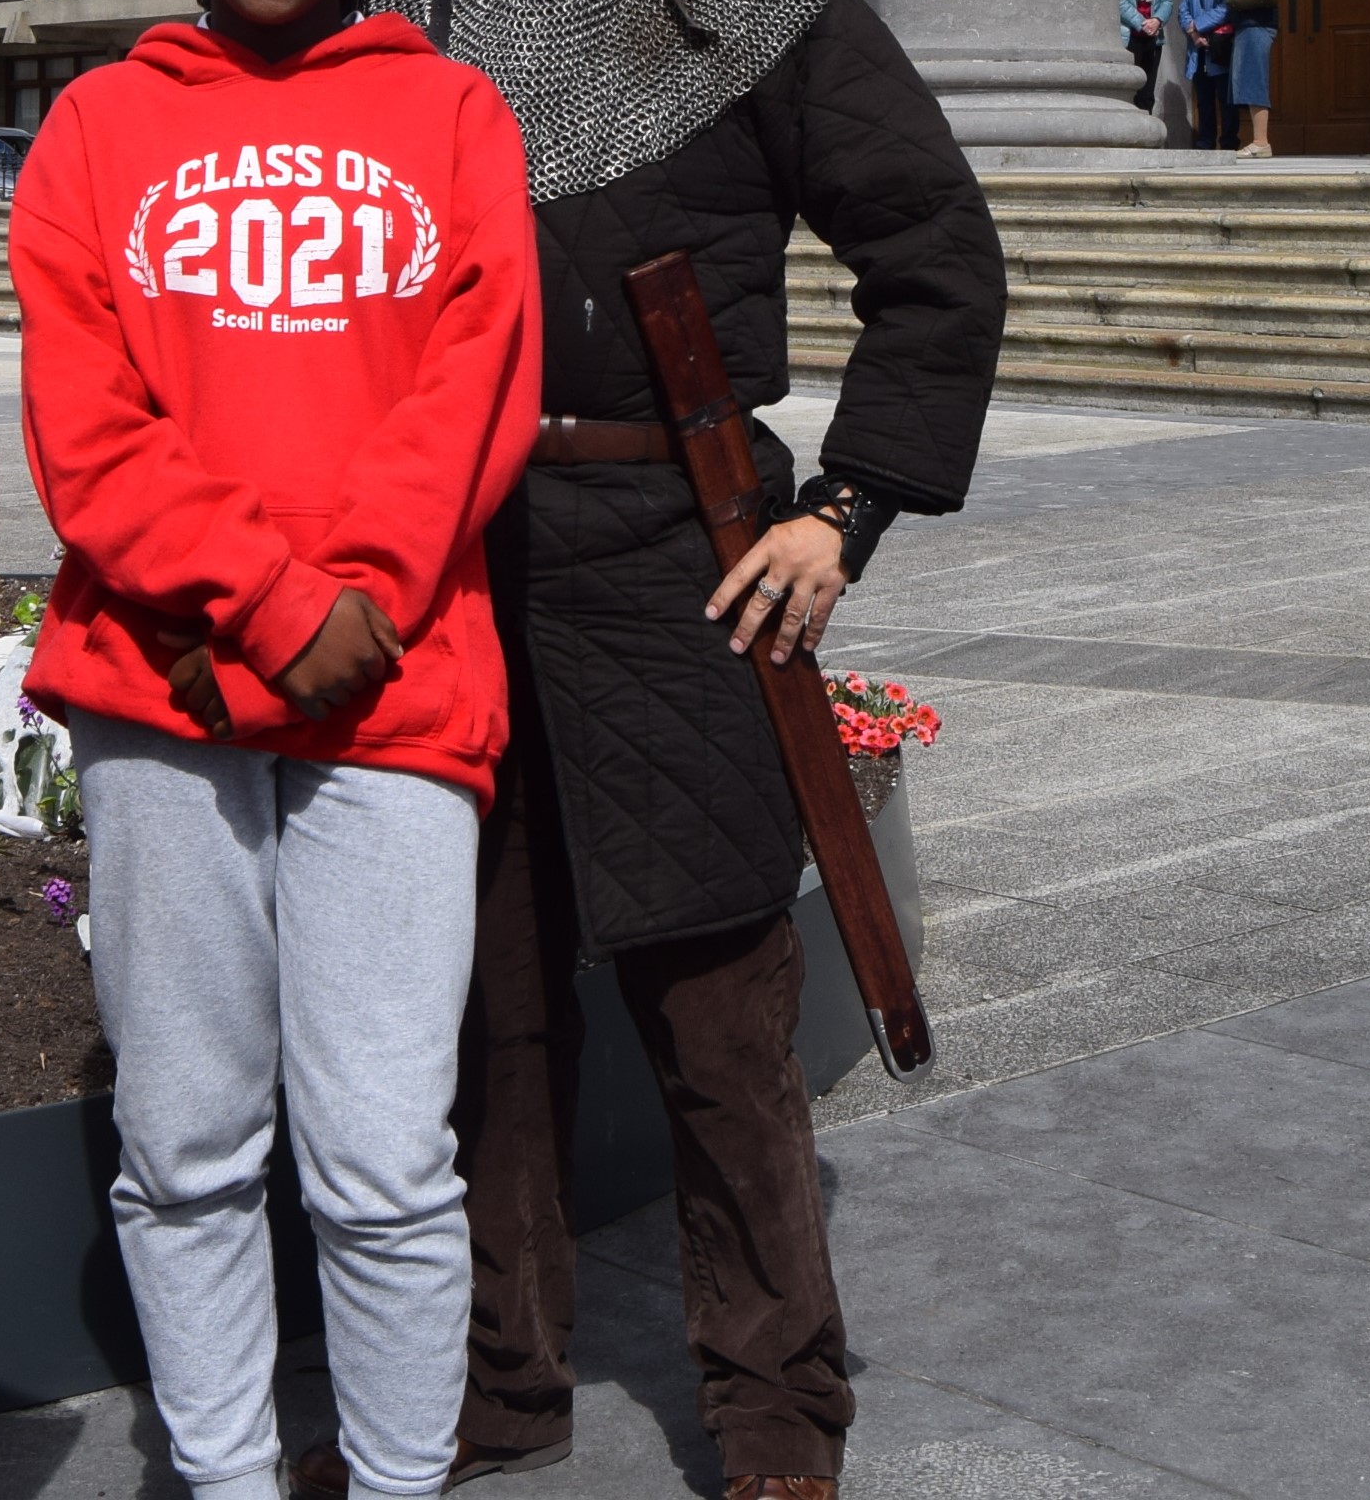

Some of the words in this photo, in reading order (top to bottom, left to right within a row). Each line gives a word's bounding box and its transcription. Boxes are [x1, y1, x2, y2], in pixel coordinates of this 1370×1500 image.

[174, 144, 322, 200] CLASS
[336, 149, 392, 198] OF
[163, 195, 390, 308] 2021
[212, 308, 263, 332] Scoil
[270, 313, 349, 333] Eimear
